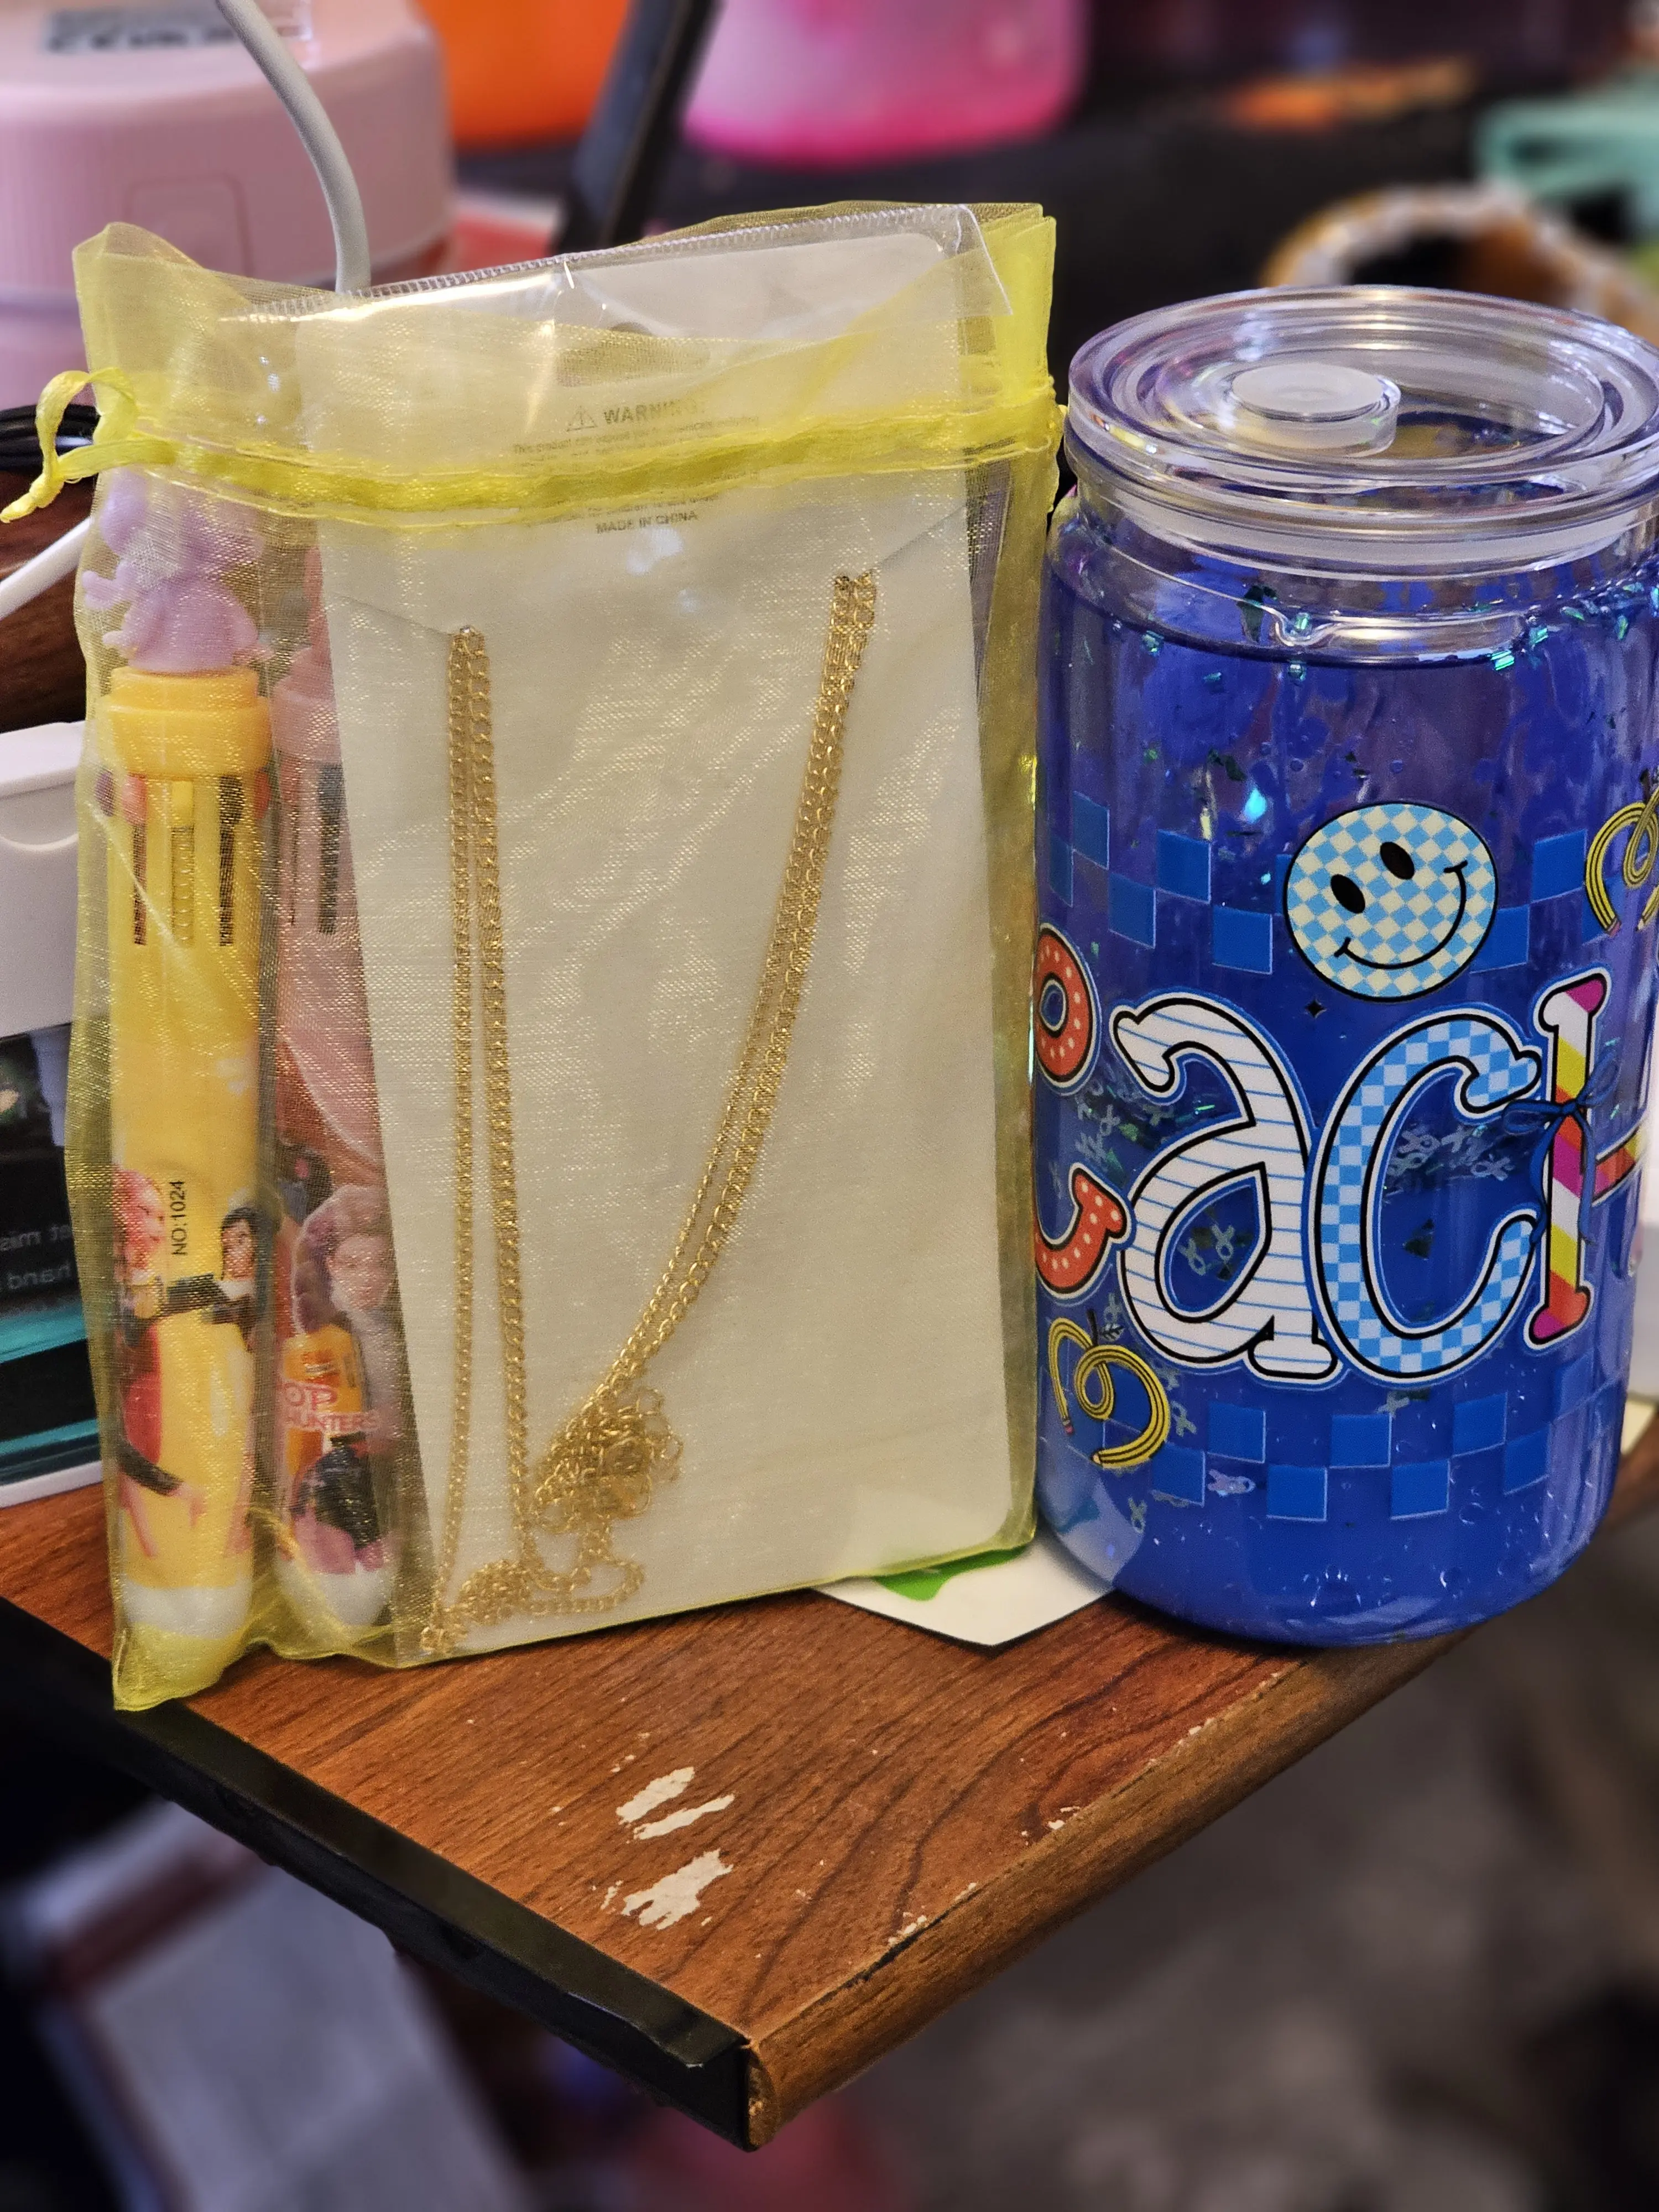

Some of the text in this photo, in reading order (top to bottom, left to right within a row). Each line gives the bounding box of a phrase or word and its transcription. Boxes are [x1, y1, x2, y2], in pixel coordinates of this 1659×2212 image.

[596, 510, 698, 535] MADE IN CHINA
[169, 1180, 188, 1256] NO:1024
